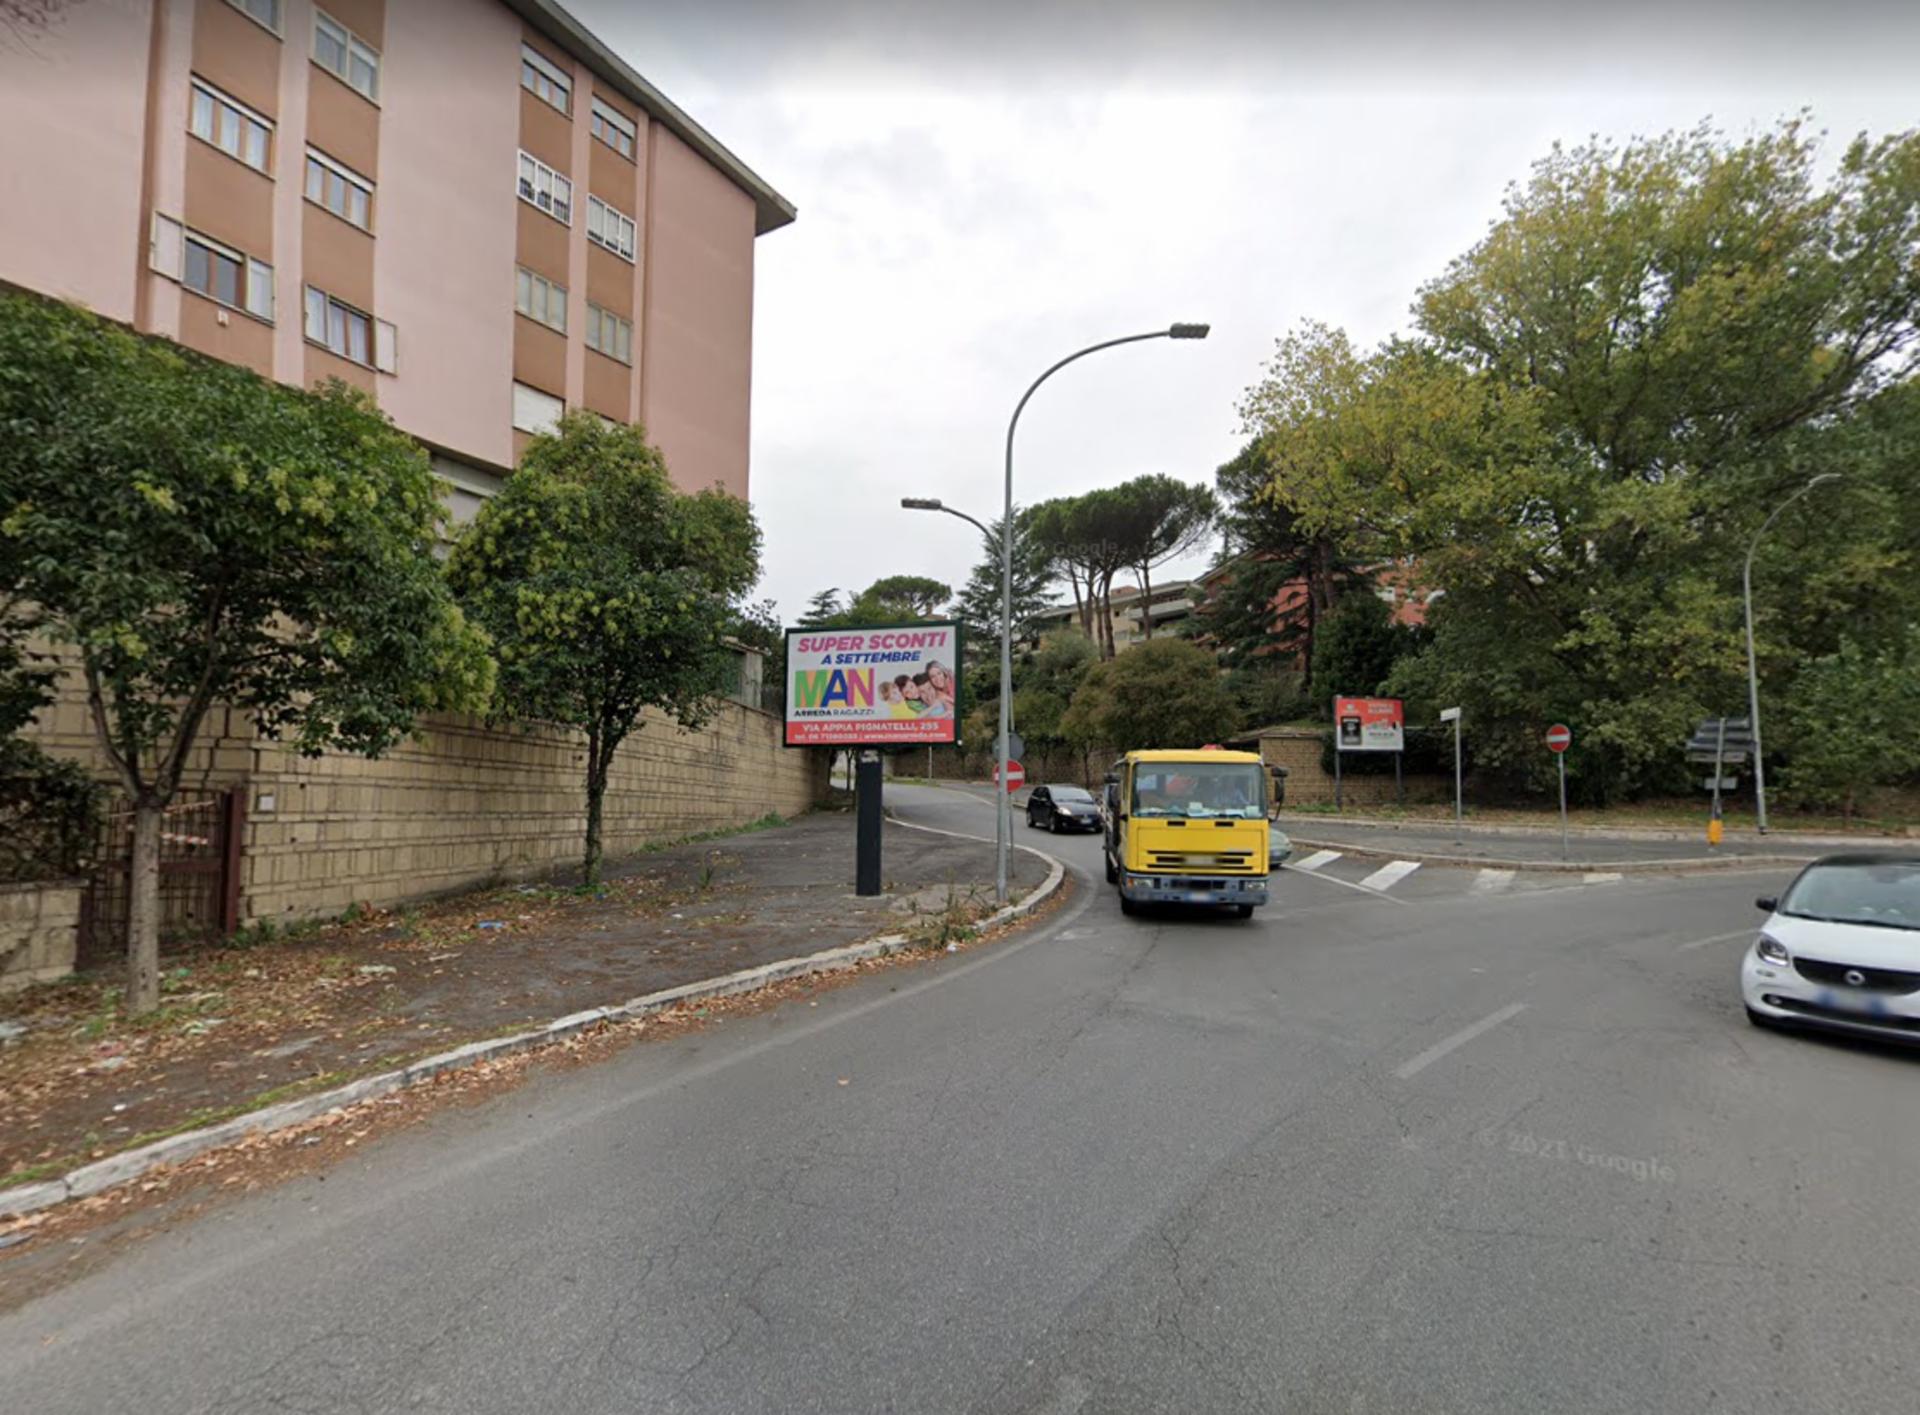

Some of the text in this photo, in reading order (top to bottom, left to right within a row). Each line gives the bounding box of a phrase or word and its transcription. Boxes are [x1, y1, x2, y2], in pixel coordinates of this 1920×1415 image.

[797, 631, 947, 653] SUPER SCONTI
[821, 651, 921, 665] A SETTEMBRE
[794, 668, 875, 708] MAN
[803, 723, 820, 732] VIA
[822, 722, 853, 732] APPIA
